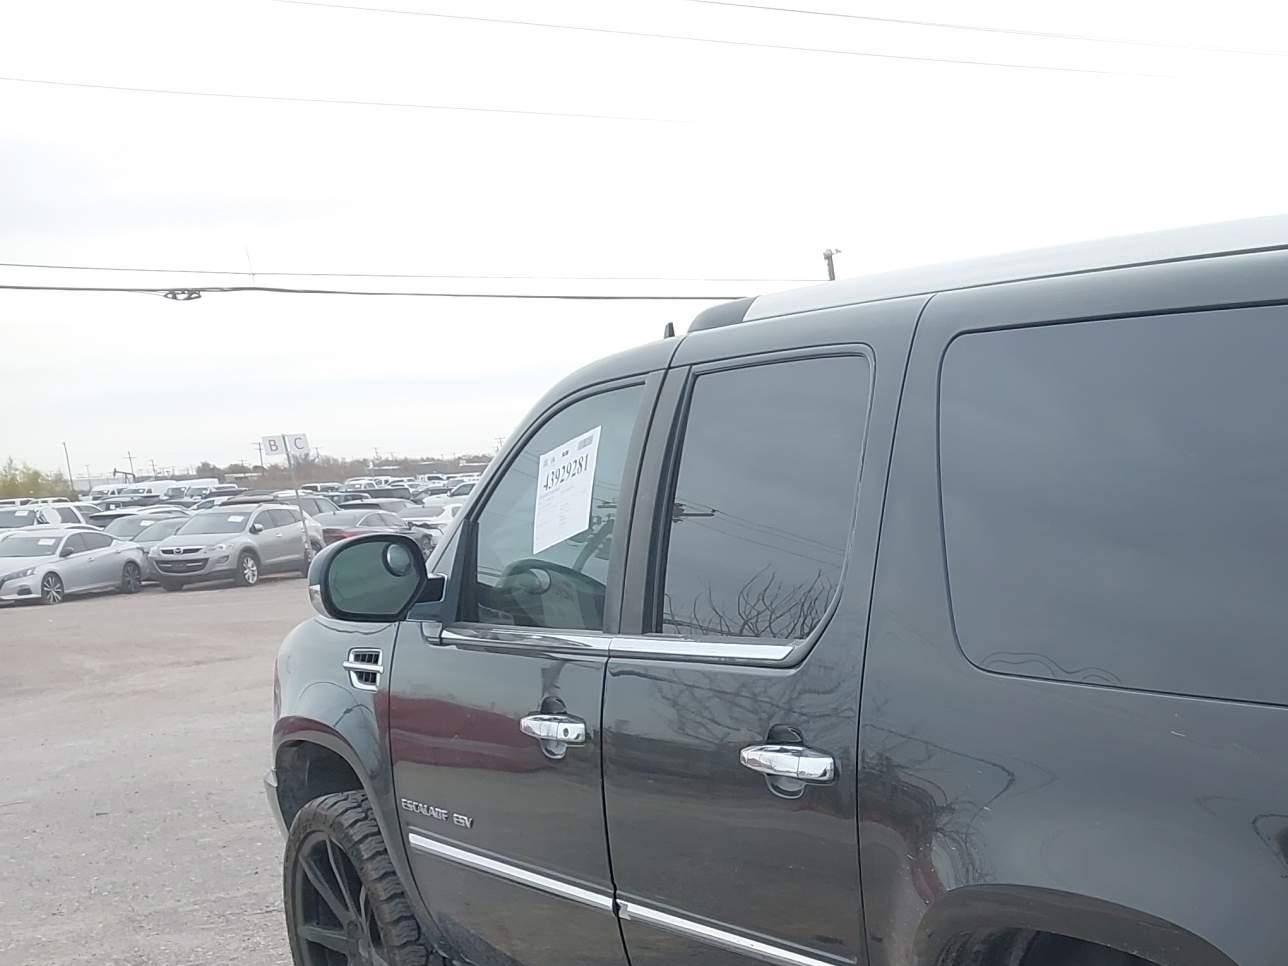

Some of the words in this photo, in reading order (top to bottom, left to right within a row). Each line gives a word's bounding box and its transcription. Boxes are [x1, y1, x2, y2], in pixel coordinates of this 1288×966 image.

[268, 439, 279, 452] B
[294, 437, 305, 450] C
[543, 453, 590, 491] 43929281
[401, 798, 448, 821] ESCALADE
[453, 813, 473, 829] ESV
